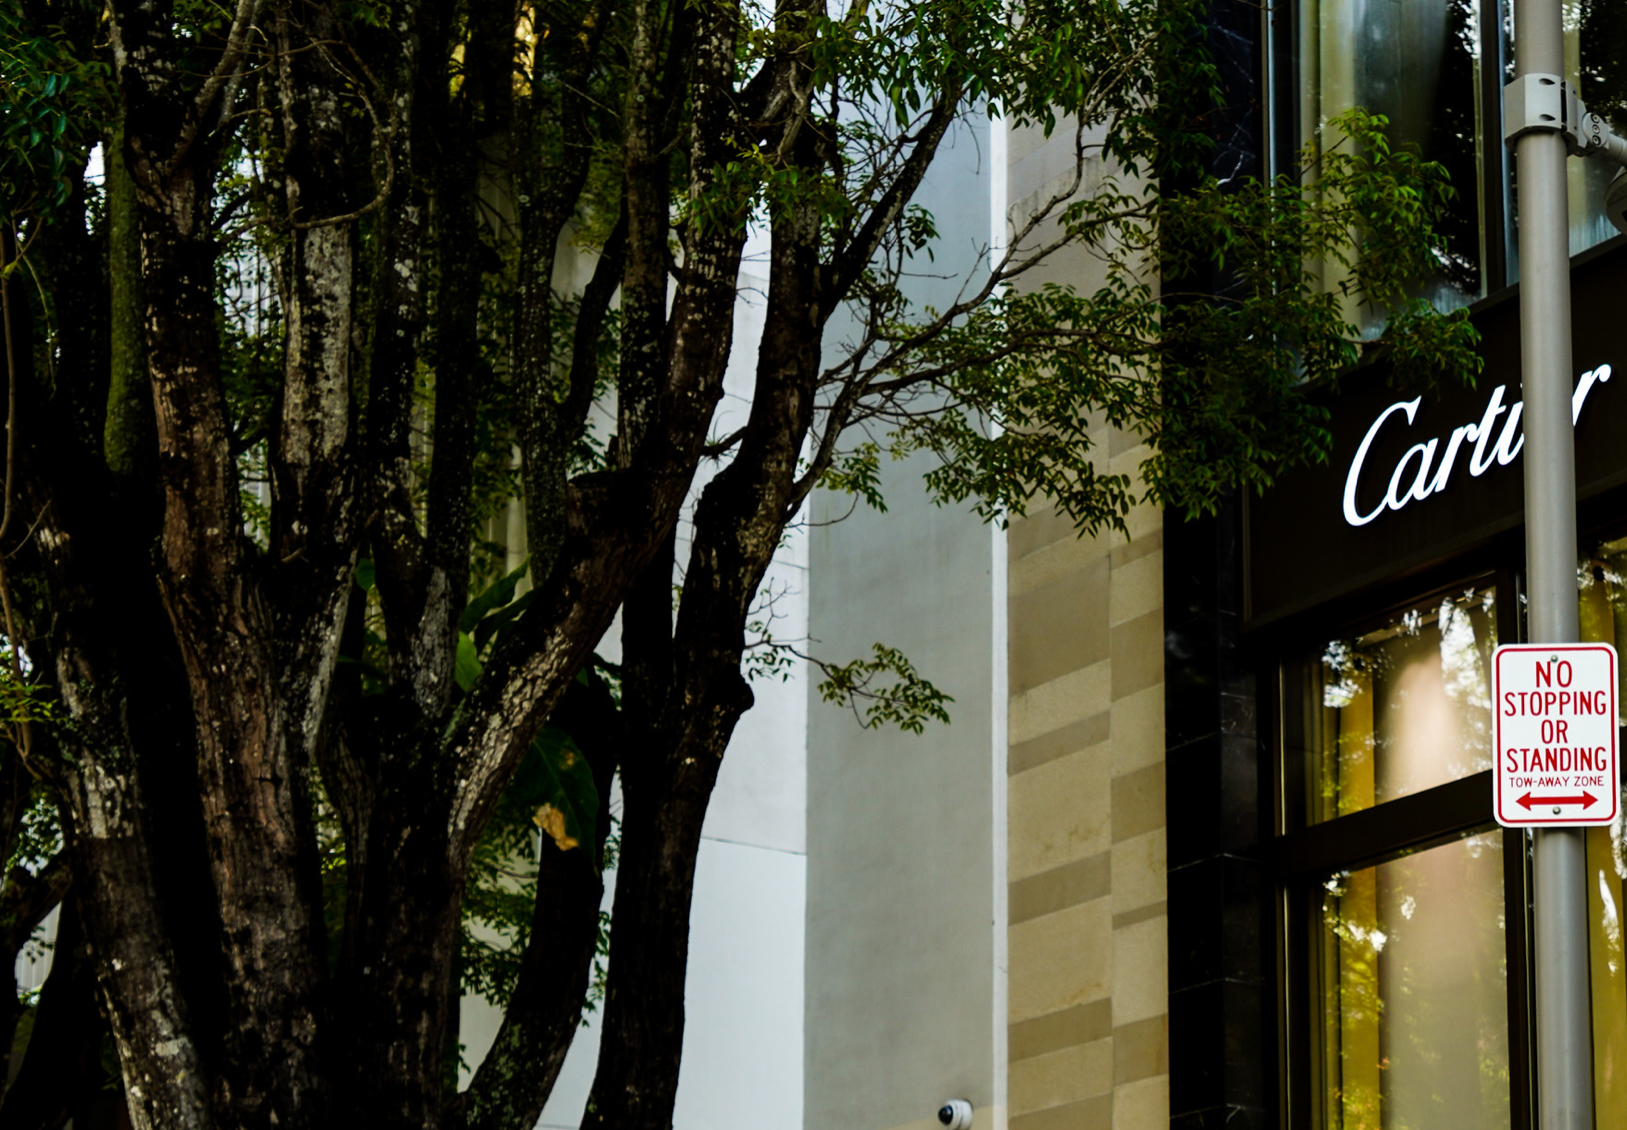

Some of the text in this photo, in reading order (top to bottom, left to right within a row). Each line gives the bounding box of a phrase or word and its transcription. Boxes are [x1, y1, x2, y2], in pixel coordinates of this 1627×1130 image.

[1343, 364, 1612, 527] Cartir
[1535, 660, 1573, 688] NO
[1504, 690, 1607, 717] STOPPING
[1541, 719, 1569, 744] OR
[1506, 746, 1607, 773] STANDING
[1509, 775, 1604, 788] TOW-AWAY ZONE
